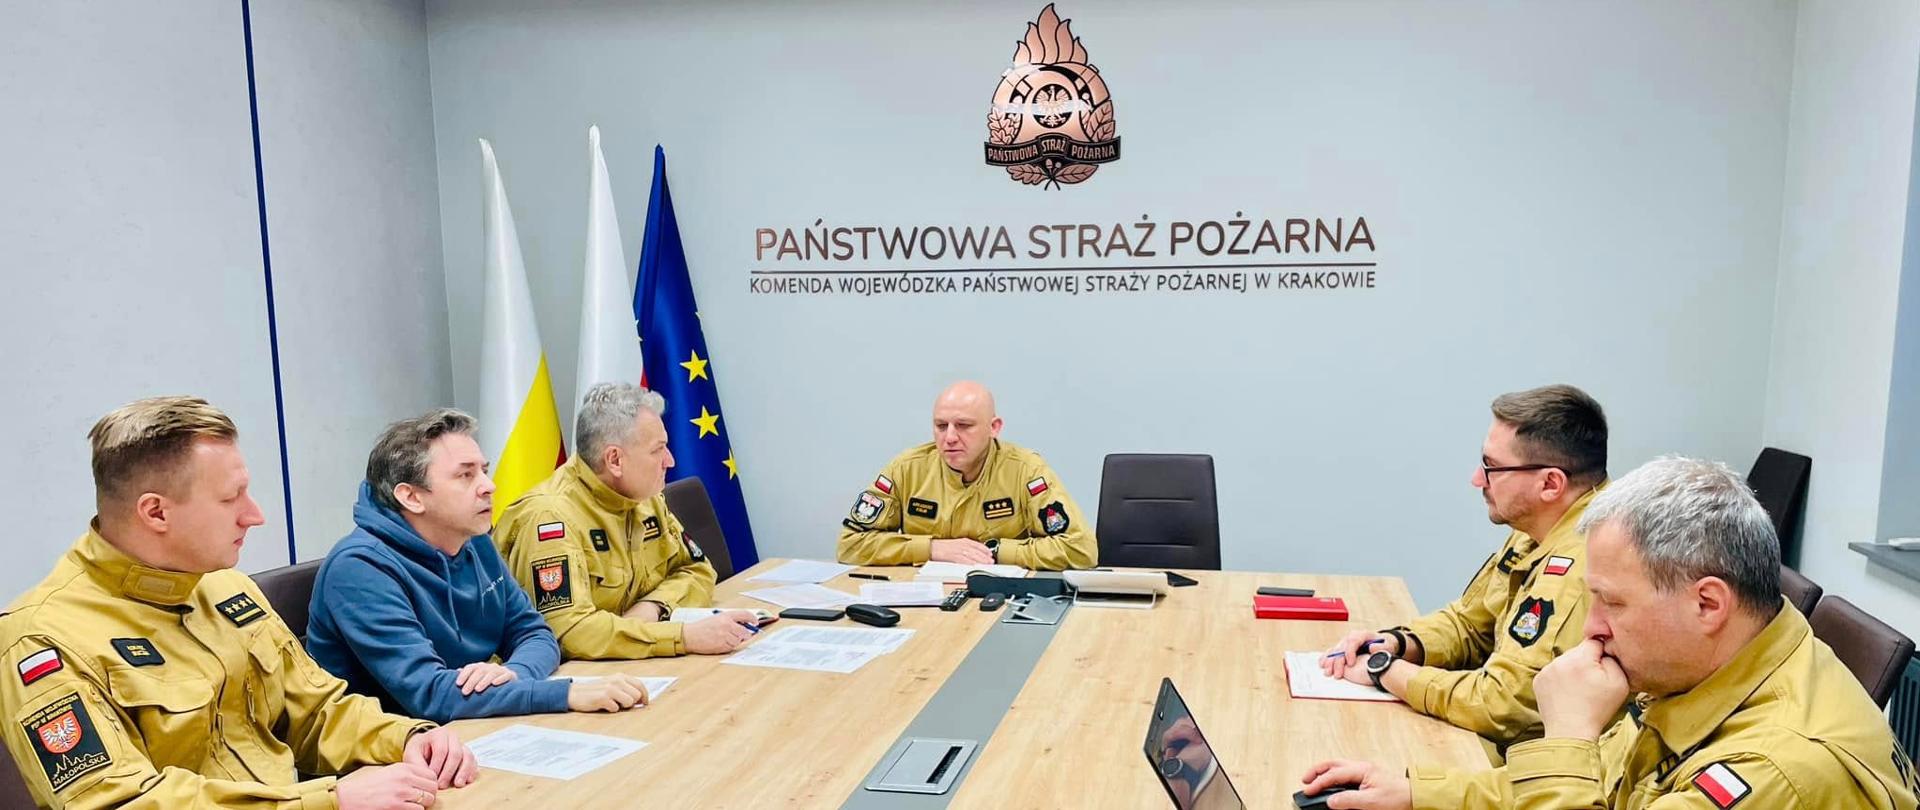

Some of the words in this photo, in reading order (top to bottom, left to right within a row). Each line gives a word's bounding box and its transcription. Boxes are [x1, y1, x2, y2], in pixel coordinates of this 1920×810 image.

[987, 145, 1038, 162] PAŃSTWOWA
[1041, 138, 1066, 152] STRAŻ
[1070, 145, 1115, 160] POŻARNA
[755, 217, 1017, 262] PAŃSTWOWA
[1027, 213, 1157, 260] STRAŻ
[1170, 210, 1376, 257] POŻARNA
[749, 276, 834, 294] KOMENDA
[837, 272, 957, 297] WOJEWÓDZKA
[962, 271, 1079, 296] PAŃSTWOWEJ
[1085, 271, 1151, 293] STRAŻY
[1156, 269, 1247, 294] POŻARNEJ
[1254, 272, 1271, 289] W
[1277, 270, 1376, 290] KRAKOWIE
[53, 755, 107, 786] MAŁOPOLSKA
